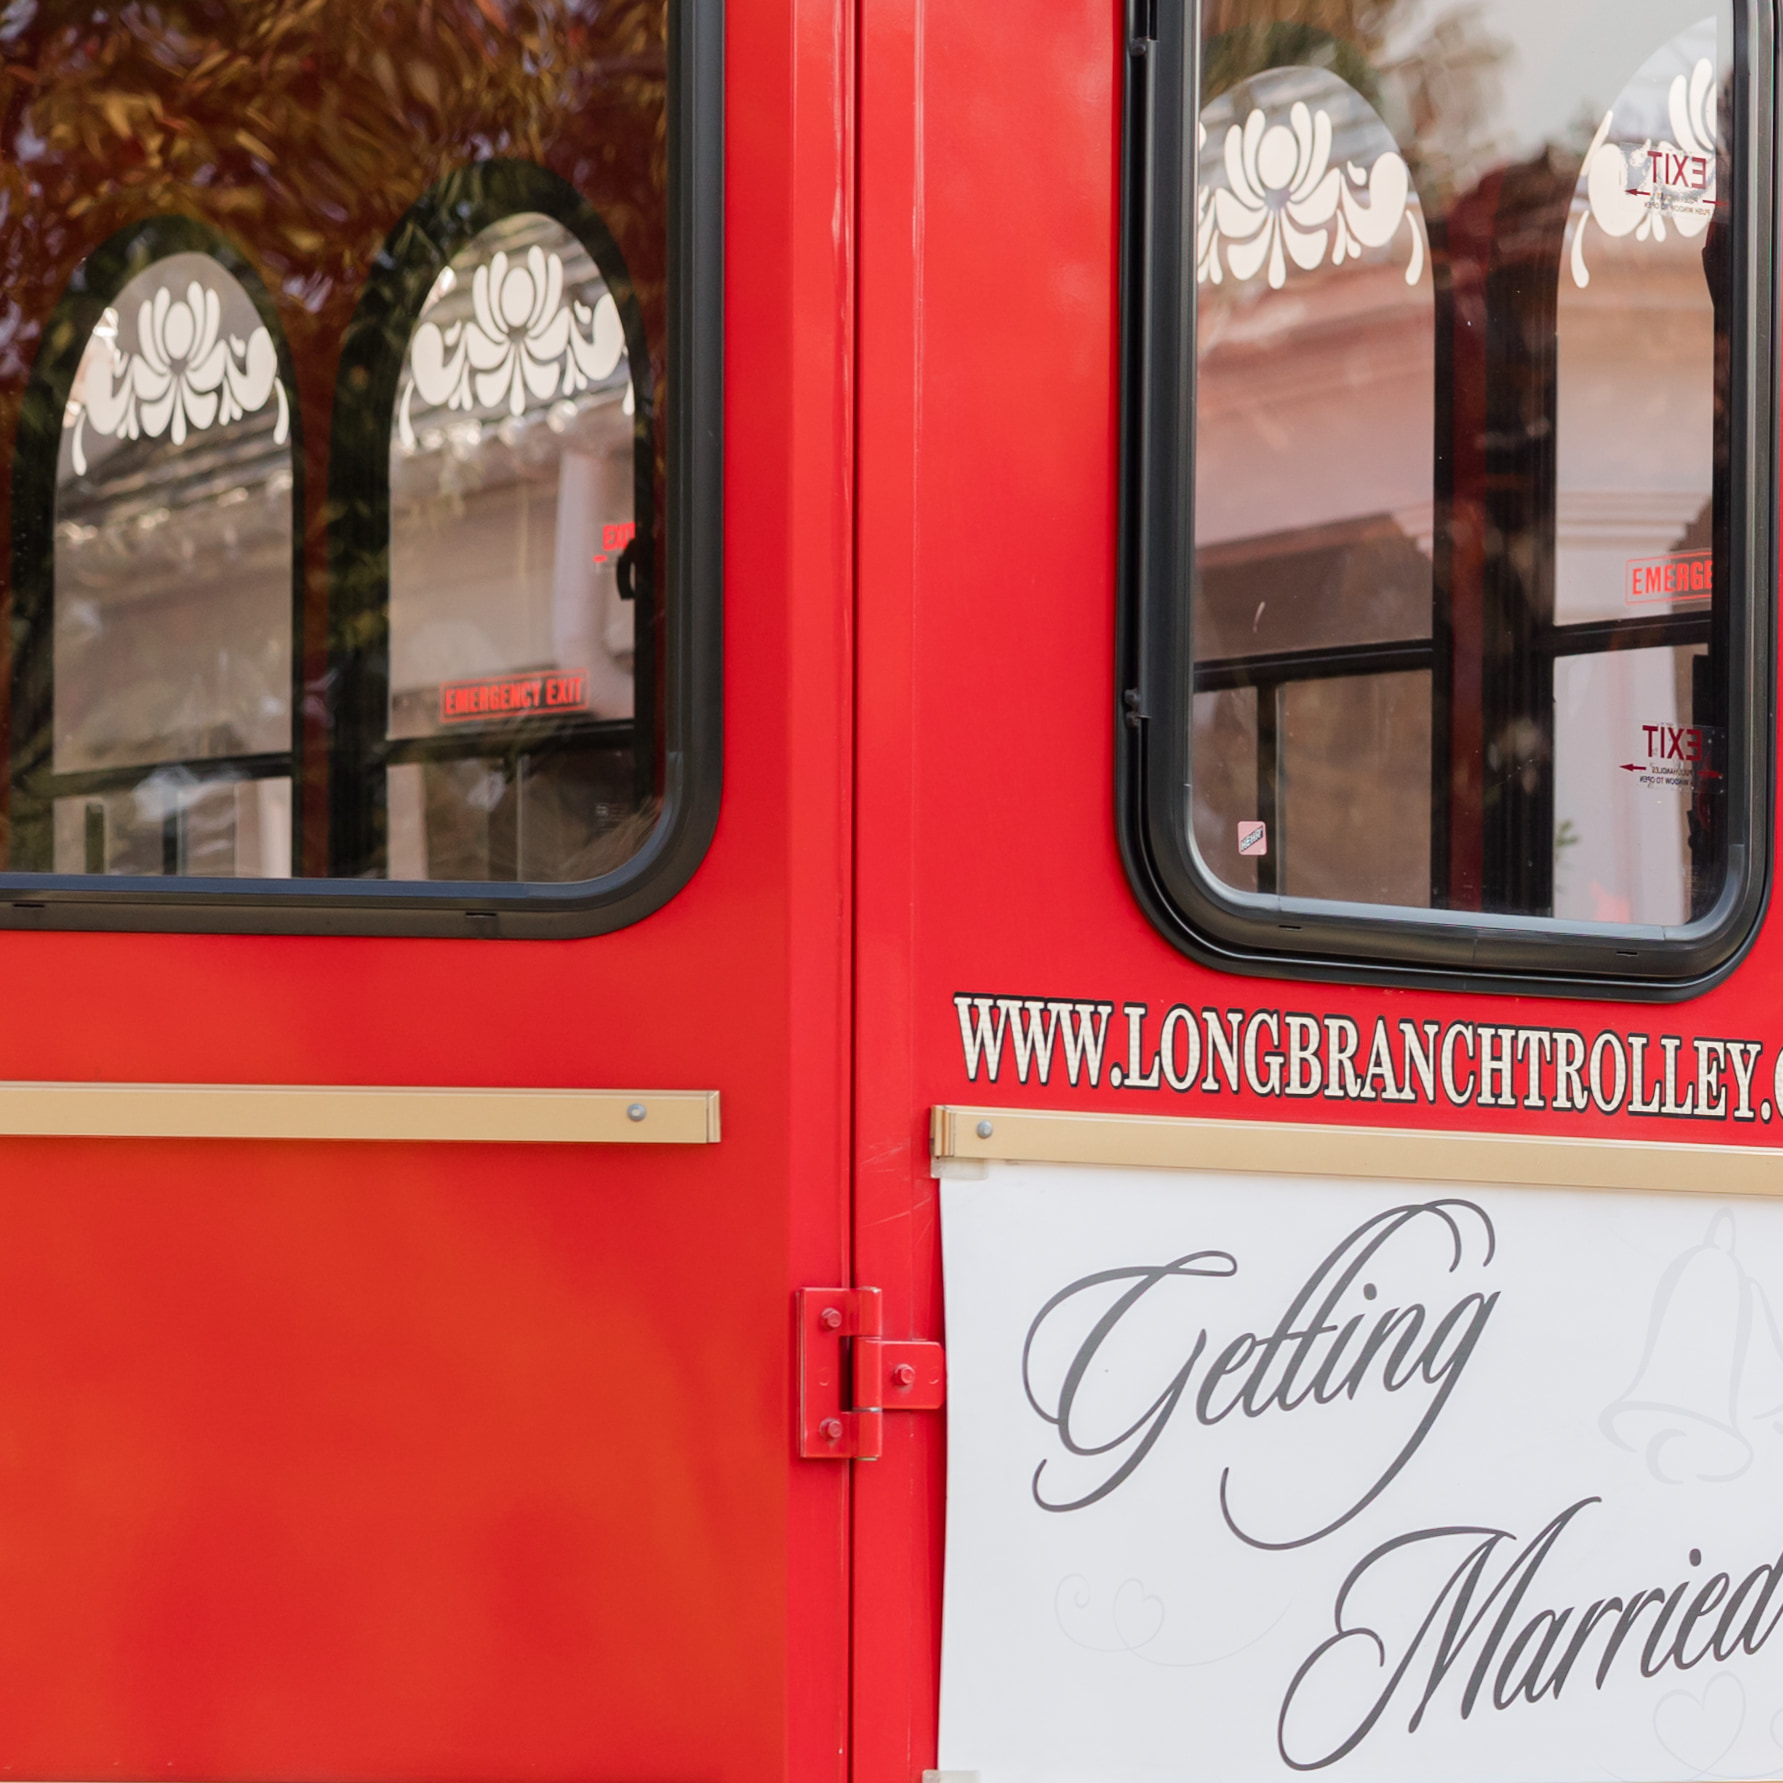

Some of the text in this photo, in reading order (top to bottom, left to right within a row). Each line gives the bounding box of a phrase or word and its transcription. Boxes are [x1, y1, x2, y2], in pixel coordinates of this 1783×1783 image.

[445, 677, 583, 715] EMERGENCY EXIT
[1022, 1199, 1501, 1550] Getting
